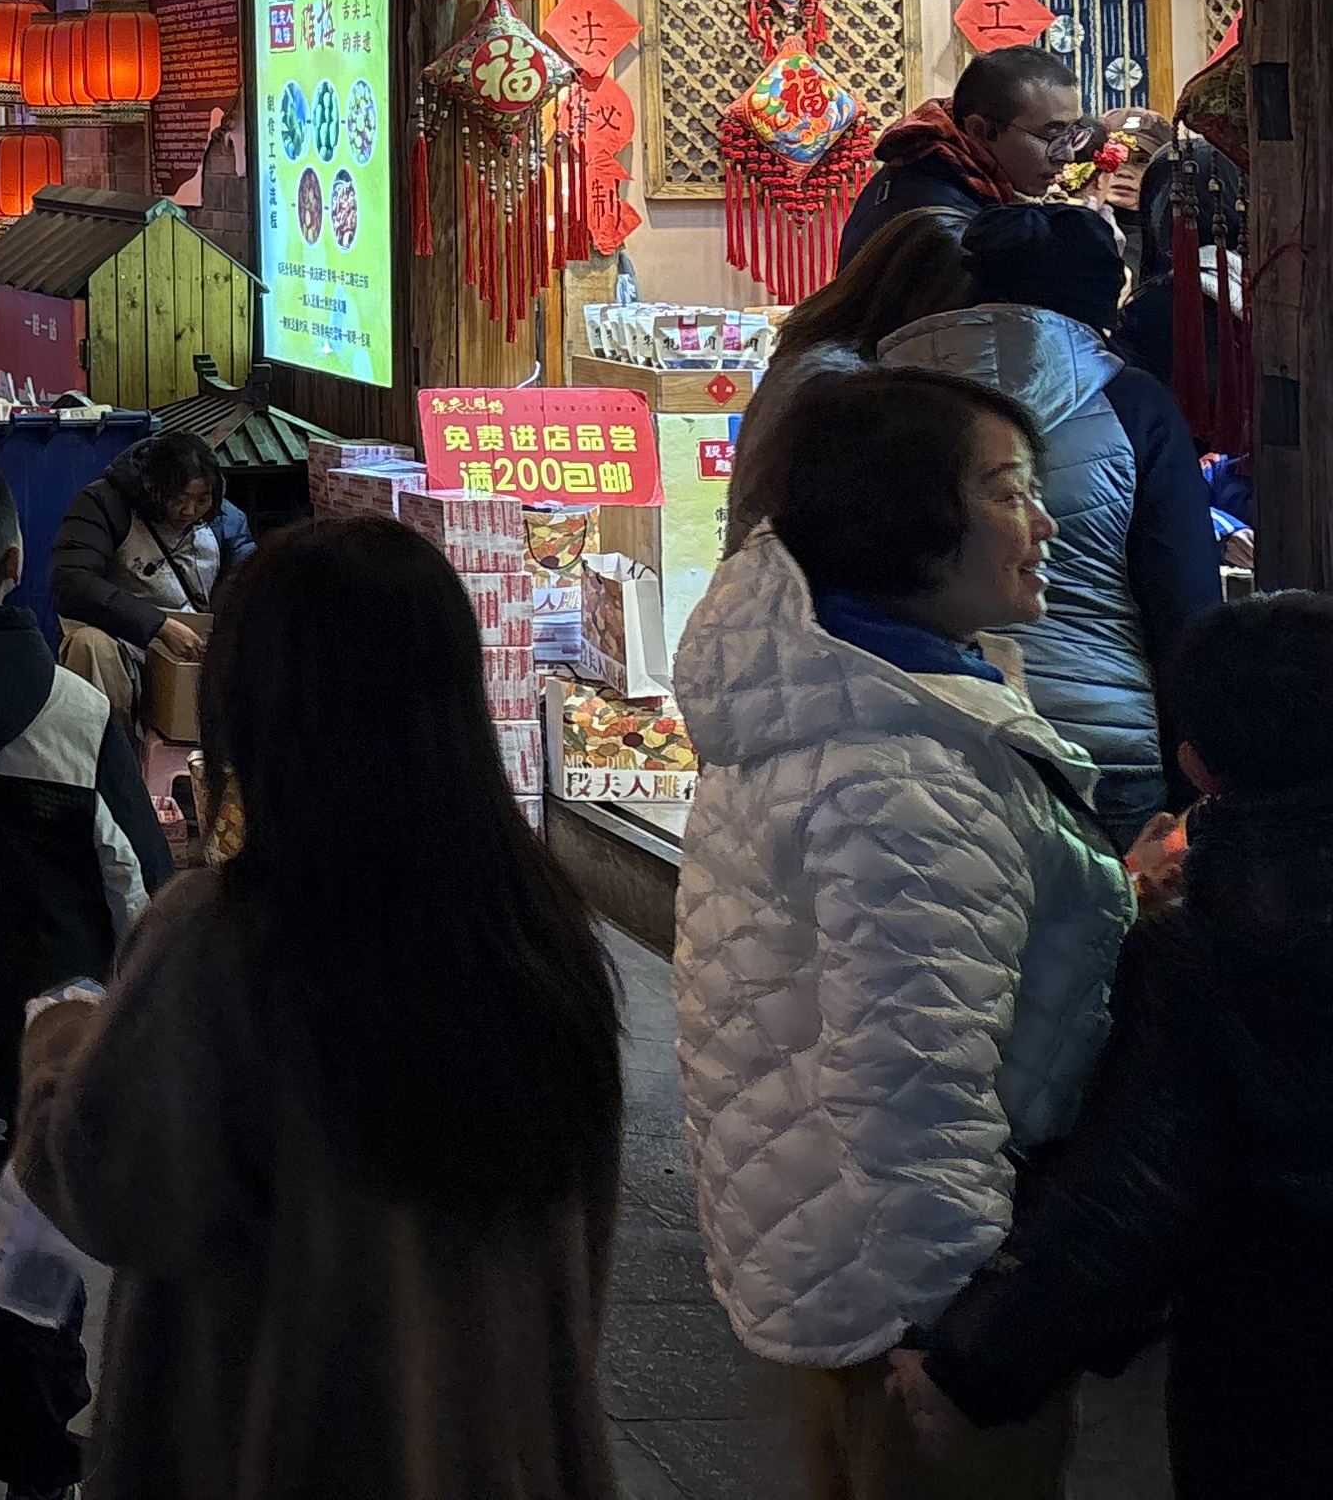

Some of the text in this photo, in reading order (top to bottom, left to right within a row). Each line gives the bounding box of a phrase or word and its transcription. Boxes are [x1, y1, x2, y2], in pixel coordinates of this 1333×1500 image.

[479, 37, 547, 103] 福
[444, 424, 638, 453] 免费进店品尝
[459, 457, 634, 494] 满200包邮
